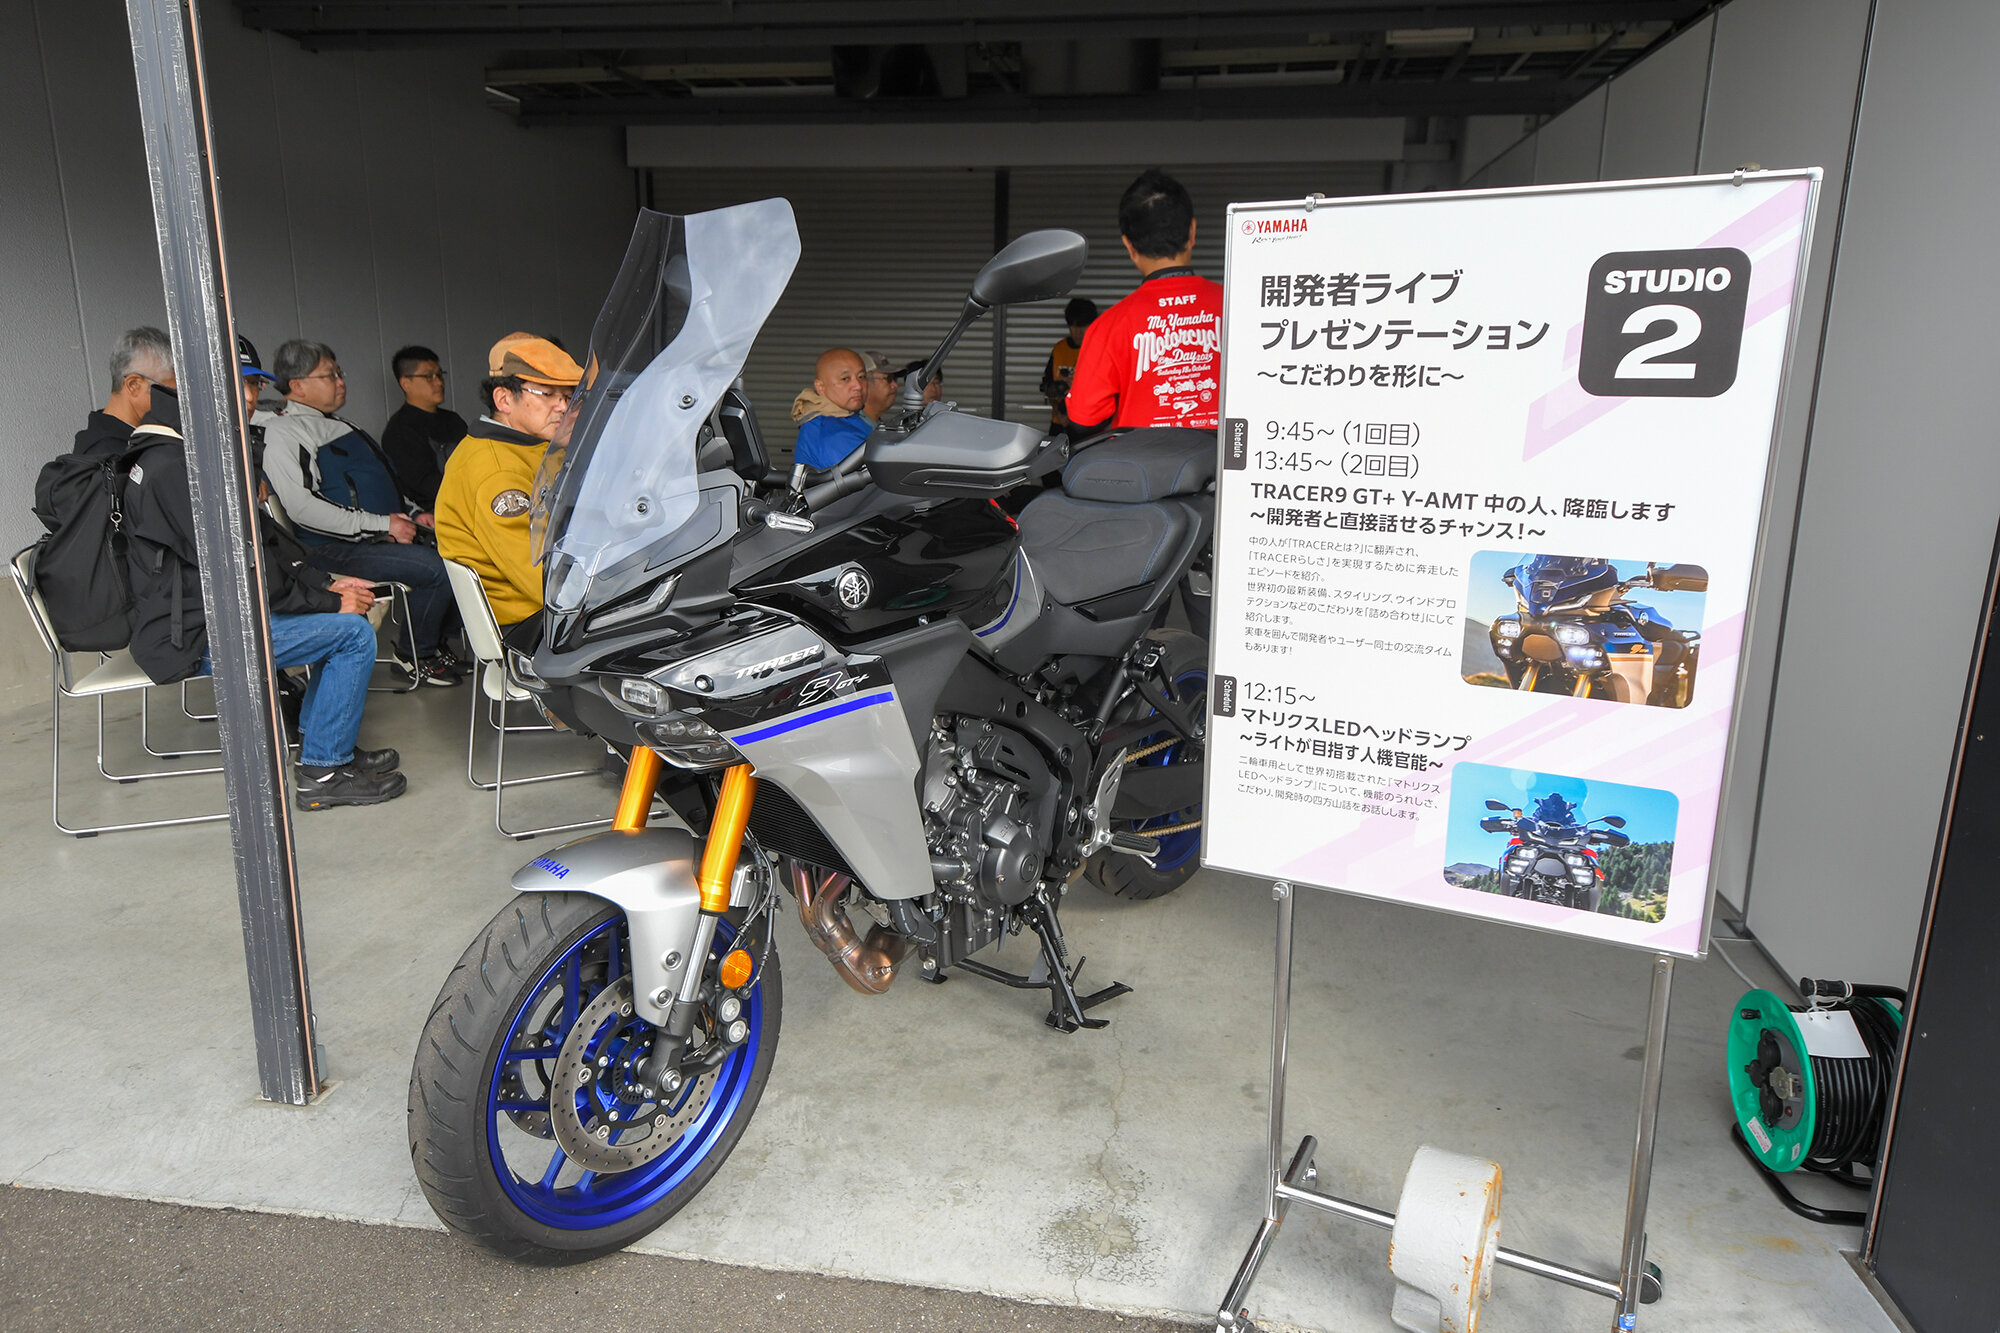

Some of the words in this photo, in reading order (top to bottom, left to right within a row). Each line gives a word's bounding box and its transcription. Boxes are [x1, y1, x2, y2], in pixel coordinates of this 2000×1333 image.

[1257, 218, 1308, 234] YAMAHA
[1260, 269, 1463, 308] 開発者ライブ
[1603, 266, 1732, 295] STUDIO
[1158, 294, 1197, 308] STAFF
[1147, 315, 1167, 333] My
[1167, 310, 1214, 330] Yamaha
[1260, 318, 1550, 351] プレゼンテーション
[1133, 316, 1221, 381] Motorcycl
[1172, 348, 1196, 365] Day
[1614, 304, 1702, 380] 2
[1233, 422, 1244, 458] Schedule
[1251, 483, 1347, 503] TRACER9
[1353, 488, 1396, 505] GT+
[1402, 490, 1478, 510] Y-AMT
[1484, 493, 1676, 522] 中の人、降臨します
[1247, 567, 1326, 582] エピソードを紹介。
[1248, 551, 1459, 577] 「TRACERらしさ」を実現するために奔走した
[1247, 582, 1456, 609] 世界初の最新装備、スタイリング、ウインドプロ
[1245, 612, 1293, 625] 紹介します。
[1246, 597, 1455, 625] テクションなどのこだわりを「詰め合わせ」にして
[1244, 627, 1452, 657] 実車を囲んで開発者やユーザー同士の交流タイム
[734, 644, 820, 680] TRACER
[798, 671, 843, 707] 9
[835, 674, 870, 690] GT+
[1223, 679, 1233, 713] Schedule
[1240, 708, 1472, 751] マトリクスLEDヘッドランプ
[530, 857, 570, 879] AMAHA
